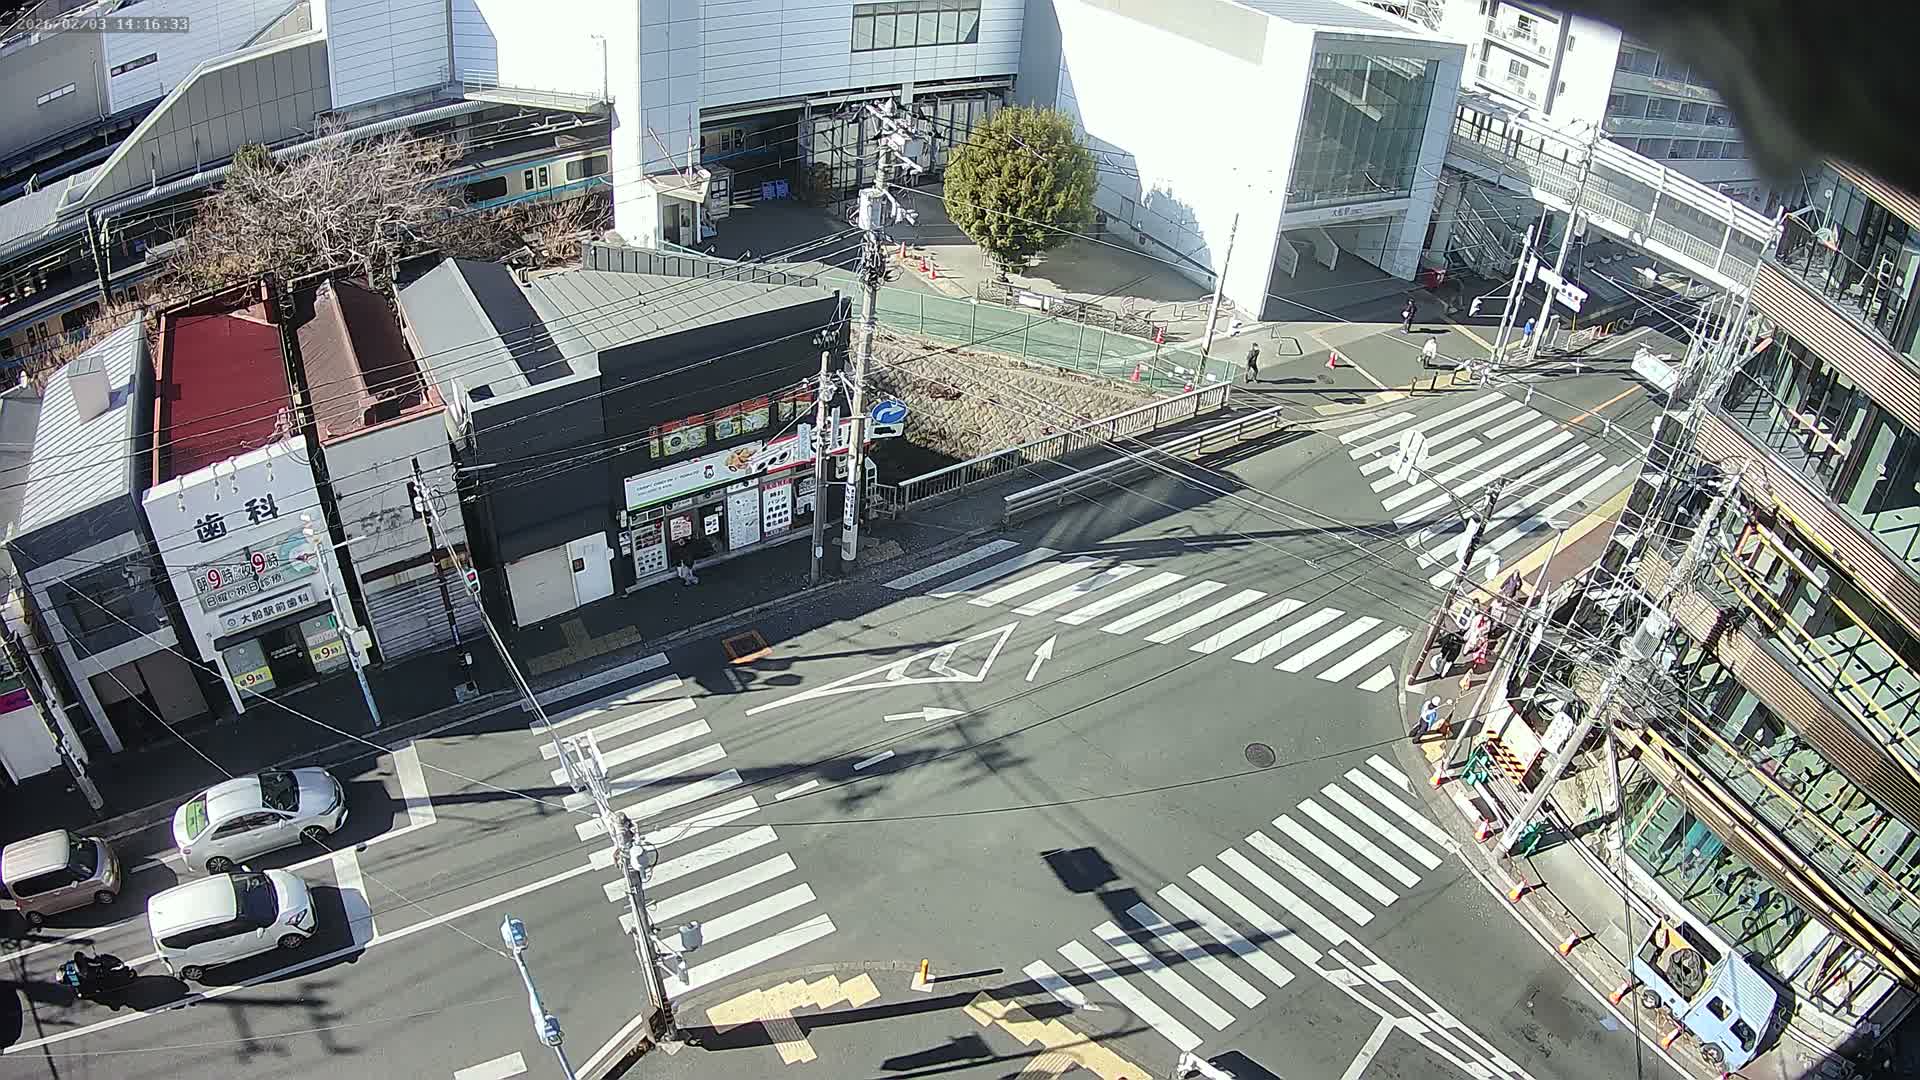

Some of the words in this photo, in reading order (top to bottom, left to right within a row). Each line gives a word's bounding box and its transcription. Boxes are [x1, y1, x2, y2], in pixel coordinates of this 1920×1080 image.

[193, 493, 279, 543] 歯科
[241, 593, 310, 625] 大船駅前歯科
